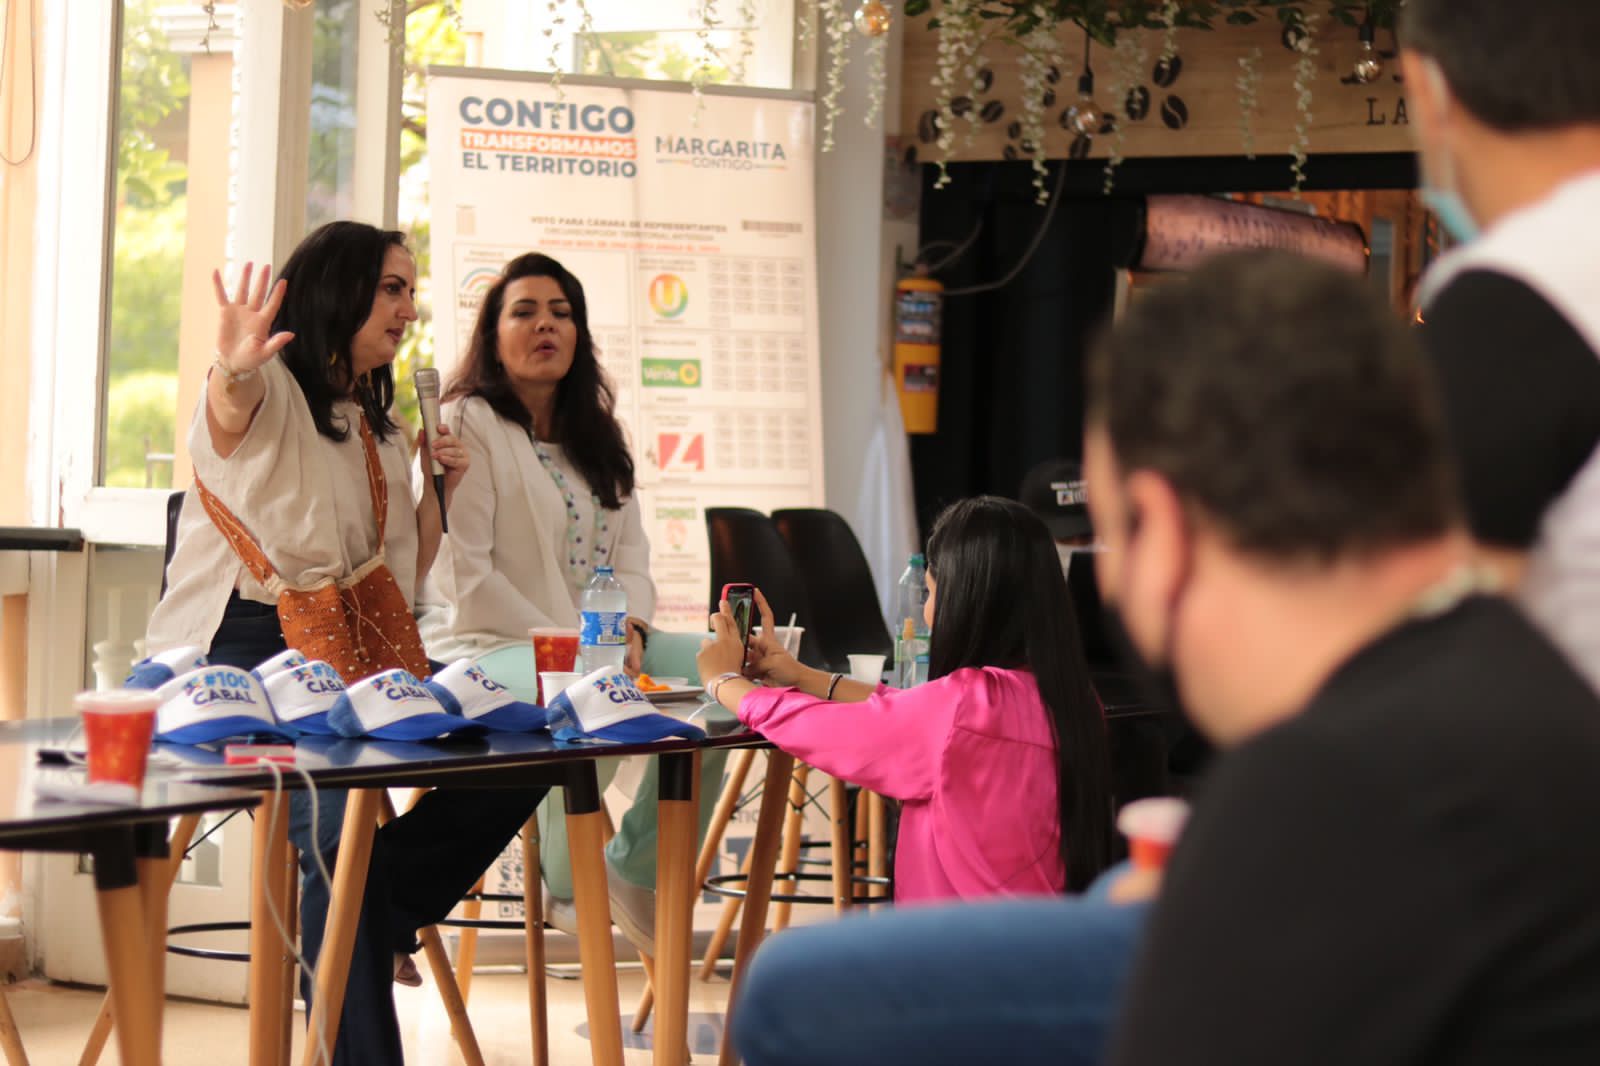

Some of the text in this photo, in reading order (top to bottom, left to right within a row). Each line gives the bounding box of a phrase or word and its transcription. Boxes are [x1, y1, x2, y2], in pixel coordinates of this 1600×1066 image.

[459, 96, 635, 134] CONTIGO
[463, 131, 637, 157] TRANSFORMAMOS
[655, 135, 787, 160] MARGARITA
[462, 152, 637, 177] EL TERRITORIO
[691, 157, 753, 171] CONTIGO
